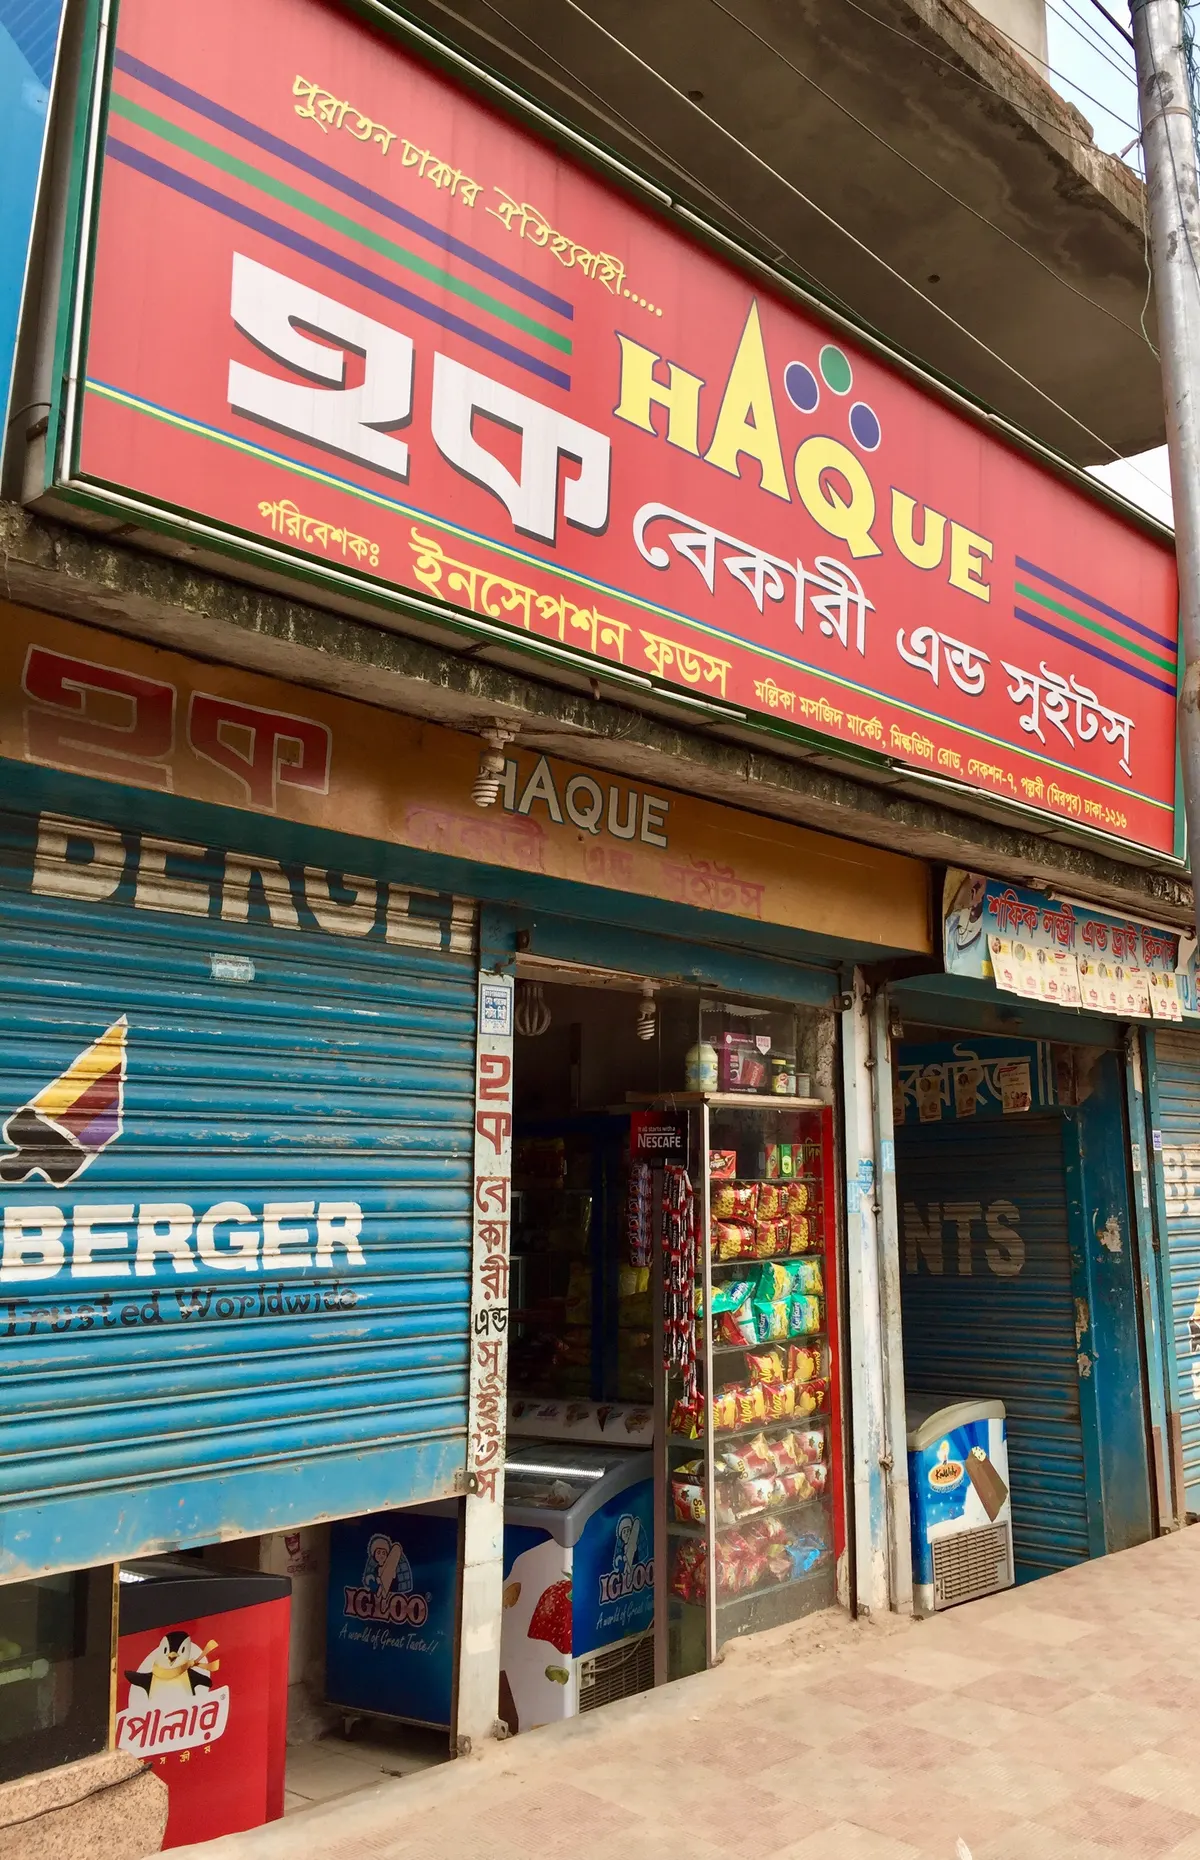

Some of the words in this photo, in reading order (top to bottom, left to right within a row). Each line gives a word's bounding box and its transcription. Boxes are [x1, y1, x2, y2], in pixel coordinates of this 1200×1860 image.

[291, 74, 396, 155] পুরাতন
[400, 138, 484, 208] ঢাকার
[226, 250, 612, 547] হক
[613, 296, 994, 603] HAQUE
[257, 499, 380, 569] পরিবেশকঃ
[408, 526, 632, 664] ইনসেপশন
[639, 629, 733, 698] ফুডস
[632, 502, 877, 656] বেকারী
[896, 626, 992, 695] এন্ড
[1000, 661, 1136, 778] সুইটস্
[20, 643, 332, 813] হক
[753, 677, 796, 713] মল্লিকা
[799, 697, 844, 729] মসজিদ
[845, 716, 887, 748] মার্কেট,
[938, 748, 964, 776] রোড,
[1021, 776, 1044, 800] পল্লবী
[494, 755, 669, 848] HAQUE
[0, 1201, 367, 1282] BERGER
[1, 1290, 164, 1337] Trusted
[174, 1280, 358, 1319] Worldwide
[693, 1498, 703, 1519] Sun
[343, 1586, 428, 1627] IGLOO
[599, 1559, 654, 1606] IGLOO
[116, 1701, 220, 1749] পোলার
